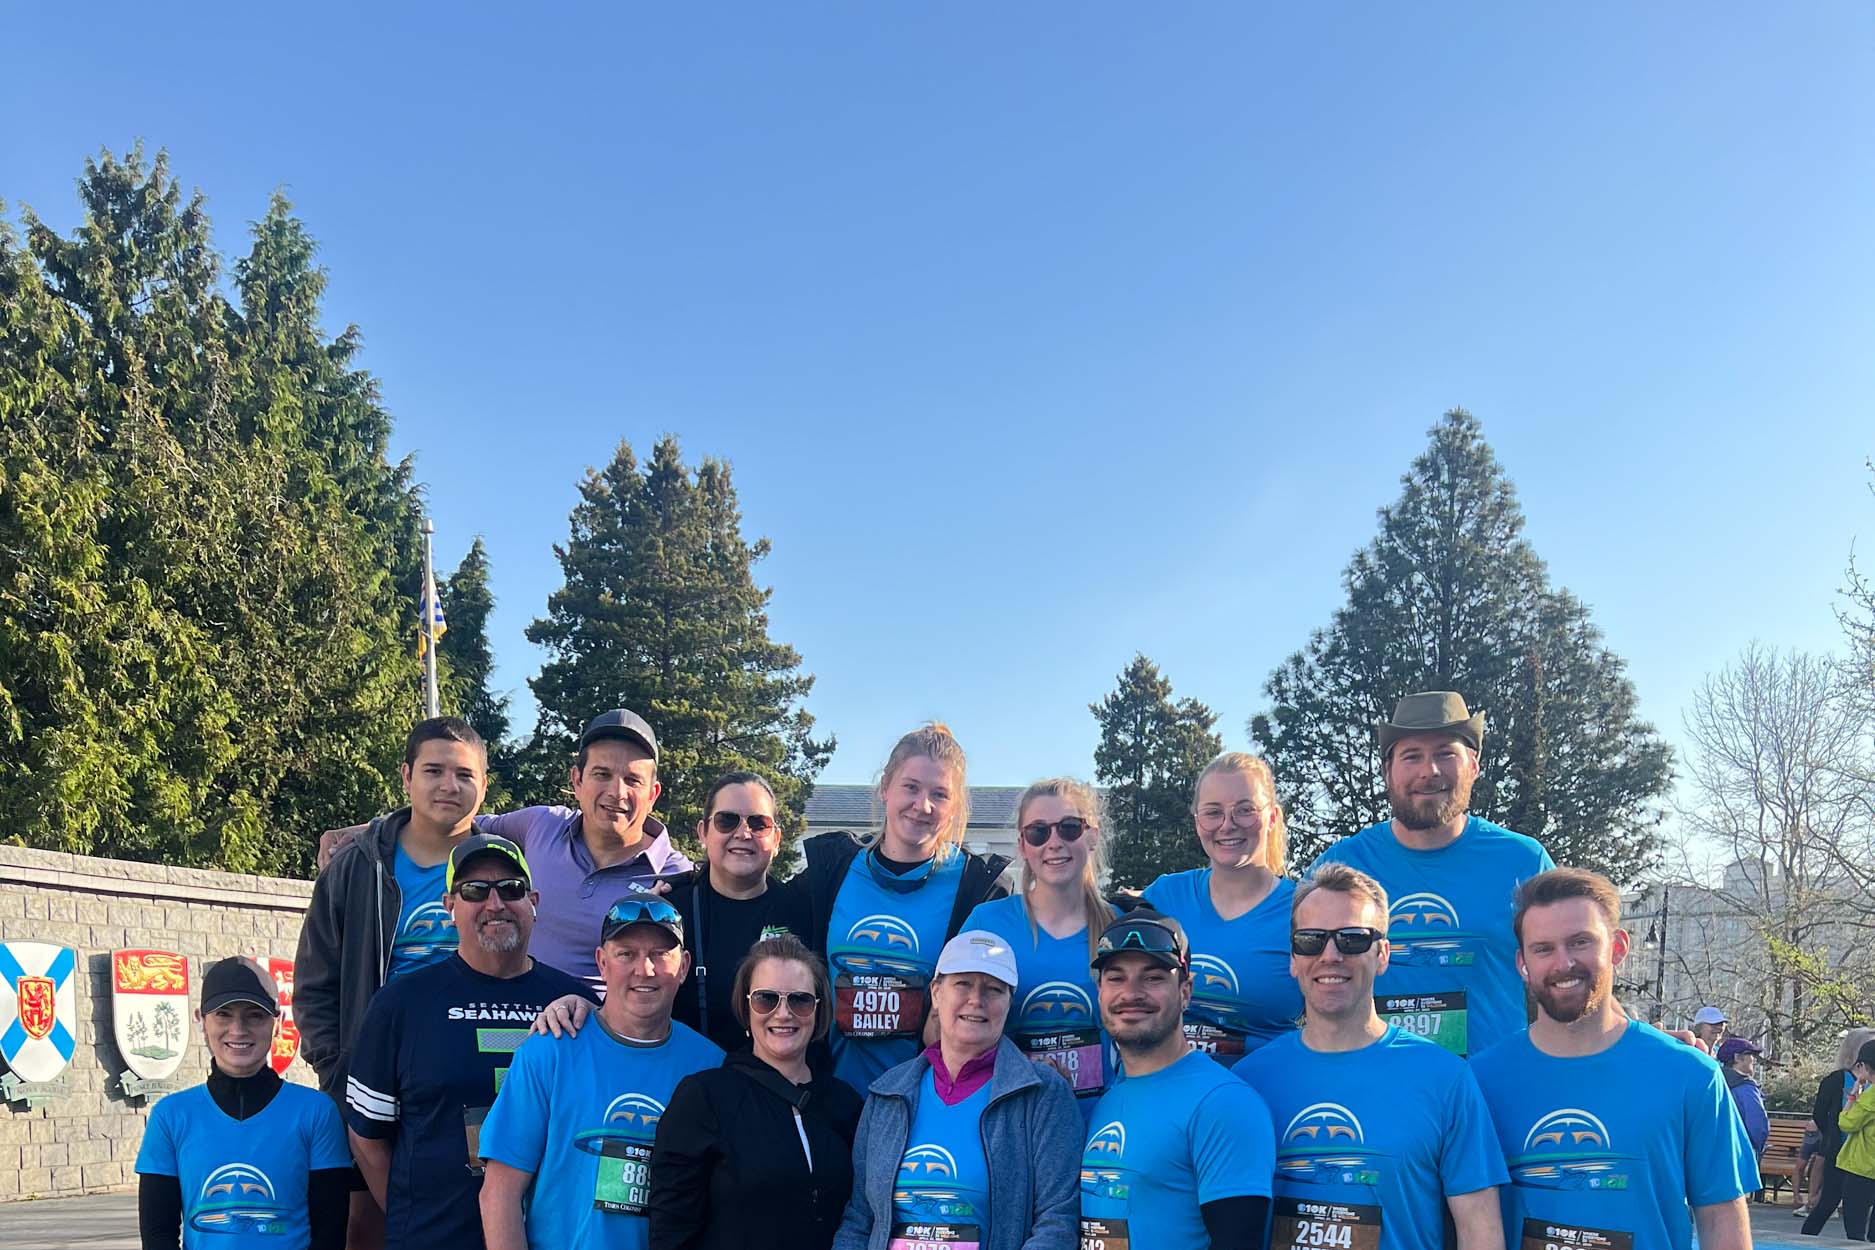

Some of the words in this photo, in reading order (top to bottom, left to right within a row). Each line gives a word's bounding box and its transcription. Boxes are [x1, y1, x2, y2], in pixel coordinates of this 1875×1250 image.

[468, 1002, 543, 1012] SEATTLE
[852, 991, 900, 1013] 4970
[447, 1006, 542, 1022] SEAHAW
[852, 1013, 900, 1030] BAILEY
[1032, 1050, 1079, 1071] 78
[622, 1162, 651, 1187] 88
[1295, 1220, 1352, 1249] 2544
